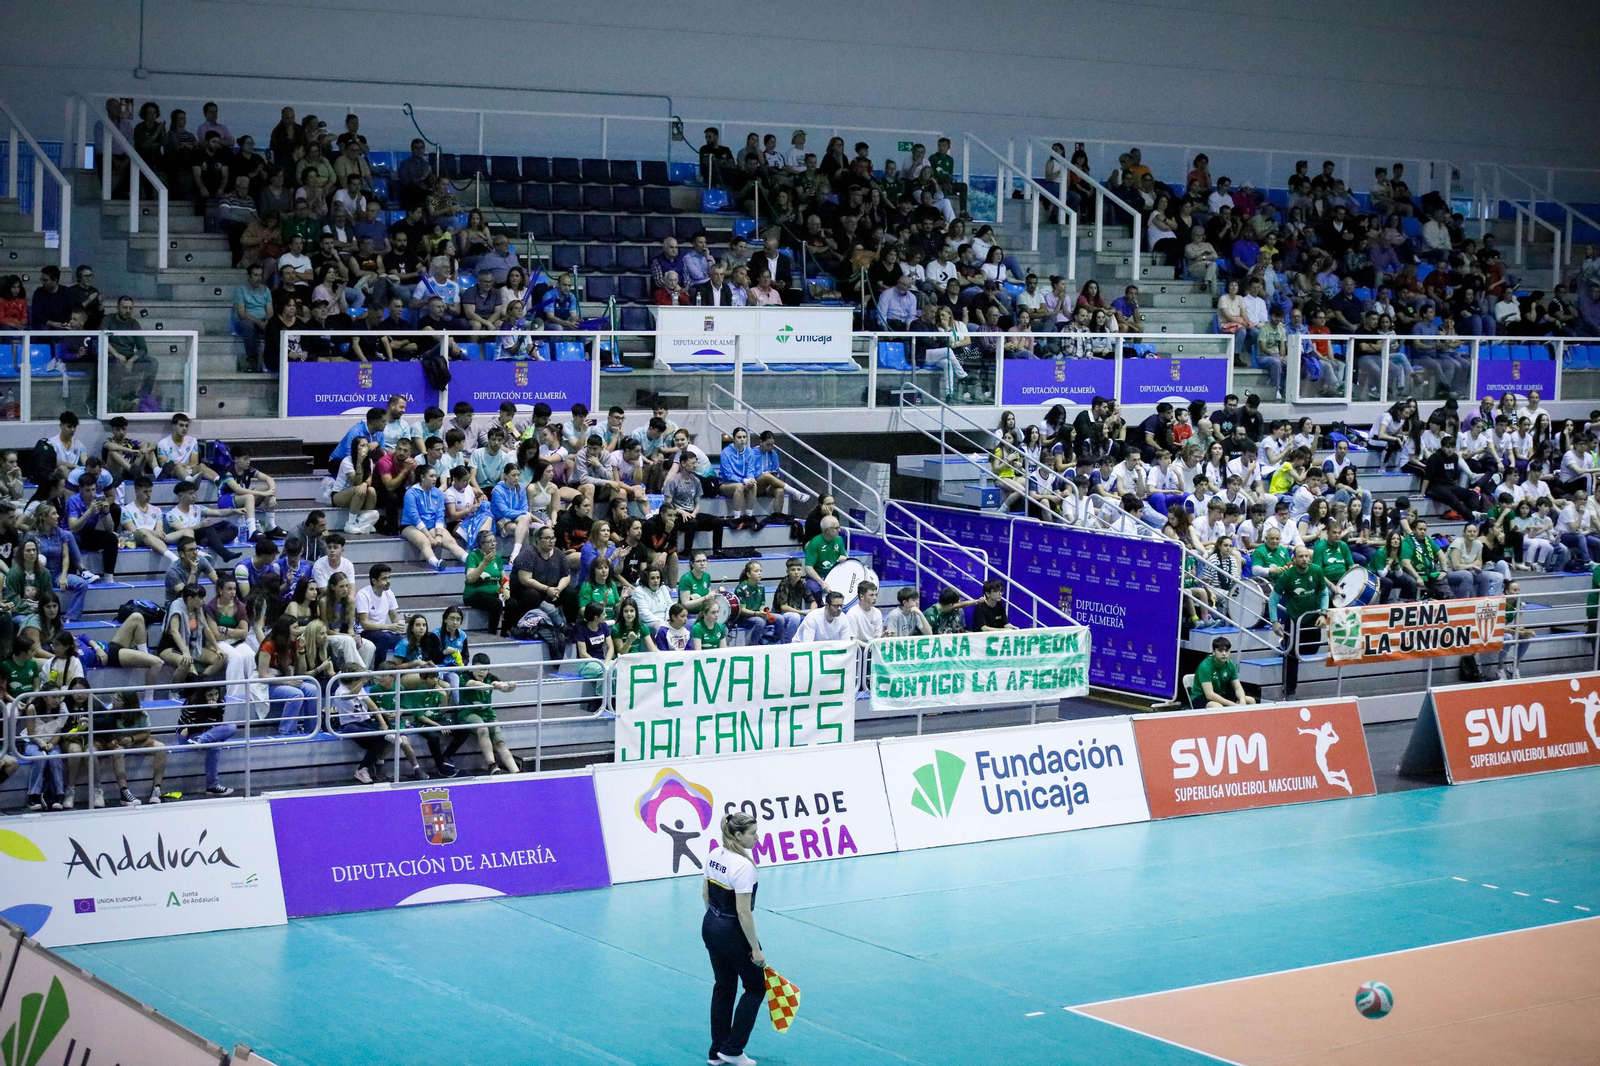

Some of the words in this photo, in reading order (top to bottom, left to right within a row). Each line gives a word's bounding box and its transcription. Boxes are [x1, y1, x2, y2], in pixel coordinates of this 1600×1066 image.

[315, 391, 365, 402] DIPUTACIÓN
[367, 394, 378, 402] DE
[473, 390, 521, 400] DIPUTACIÓN
[522, 391, 533, 400] DE
[534, 390, 567, 400] ALMERÍA
[1022, 385, 1058, 394] DIPUTACIÓN
[1059, 386, 1069, 394] DE
[1069, 385, 1096, 394] ALMERÍA
[1139, 384, 1175, 393] DIPUTACIÓN
[1175, 385, 1184, 393] DE
[1184, 384, 1209, 393] ALMERÍA
[1075, 599, 1126, 617] DIPUTACIÓN
[1076, 611, 1087, 623] DE
[1088, 614, 1125, 629] ALMERÍA
[1364, 633, 1391, 655] LA
[1400, 626, 1470, 651] UNION
[972, 671, 998, 693] LA
[1464, 702, 1547, 748] SVM
[975, 738, 1124, 781] Fundación
[1170, 732, 1269, 779] SVM
[1470, 751, 1511, 769] SUPERLIGA
[1511, 746, 1547, 763] VOLEIBOL
[1547, 741, 1589, 759] MASCULINA
[981, 775, 1090, 816] Unicaja
[1175, 784, 1225, 802] SUPERLIGA
[1225, 779, 1267, 797] VOLEIBOL
[1268, 775, 1318, 793] MASCULINA
[724, 794, 810, 821] COSTA
[814, 790, 847, 815] DE
[63, 828, 241, 879] Andalucía
[331, 855, 446, 882] DIPUTACIÓN
[450, 855, 475, 872] DE
[480, 844, 557, 869] ALMERÍA
[191, 895, 220, 904] Andalucía
